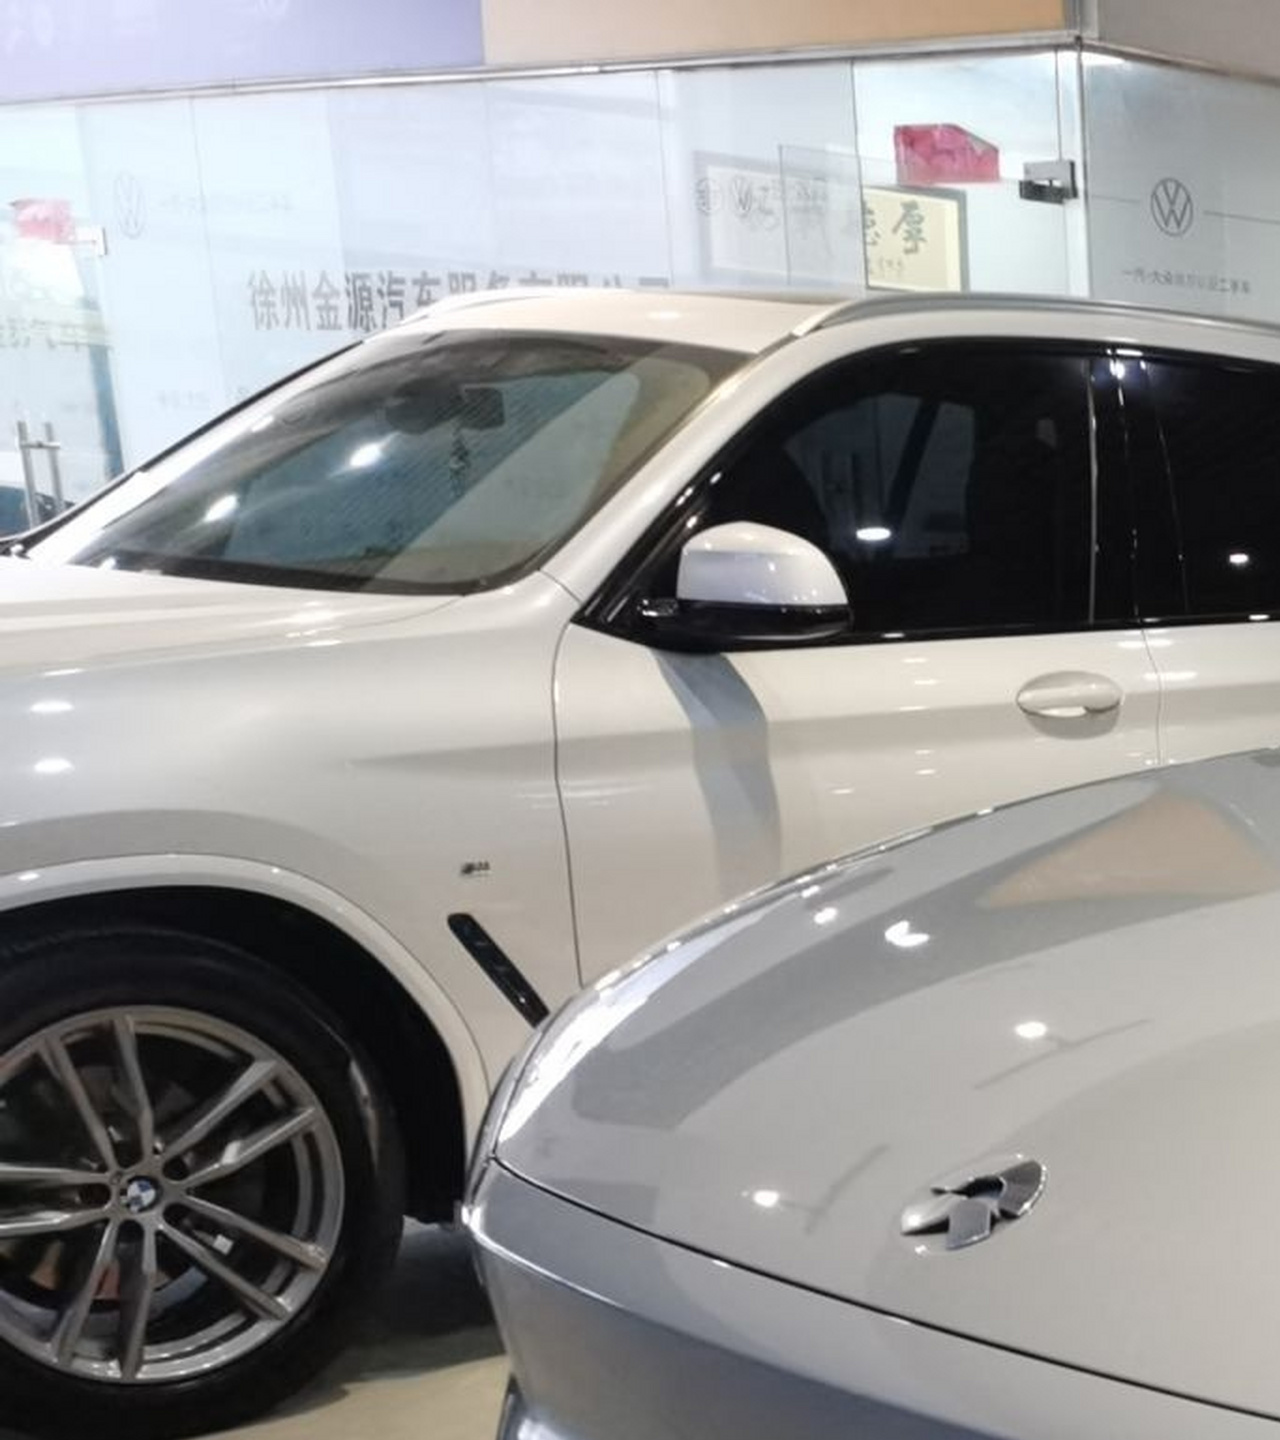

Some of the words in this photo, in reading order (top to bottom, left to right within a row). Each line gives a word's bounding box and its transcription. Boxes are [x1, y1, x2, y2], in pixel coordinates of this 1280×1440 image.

[246, 269, 670, 331] 徐州金源汽车
